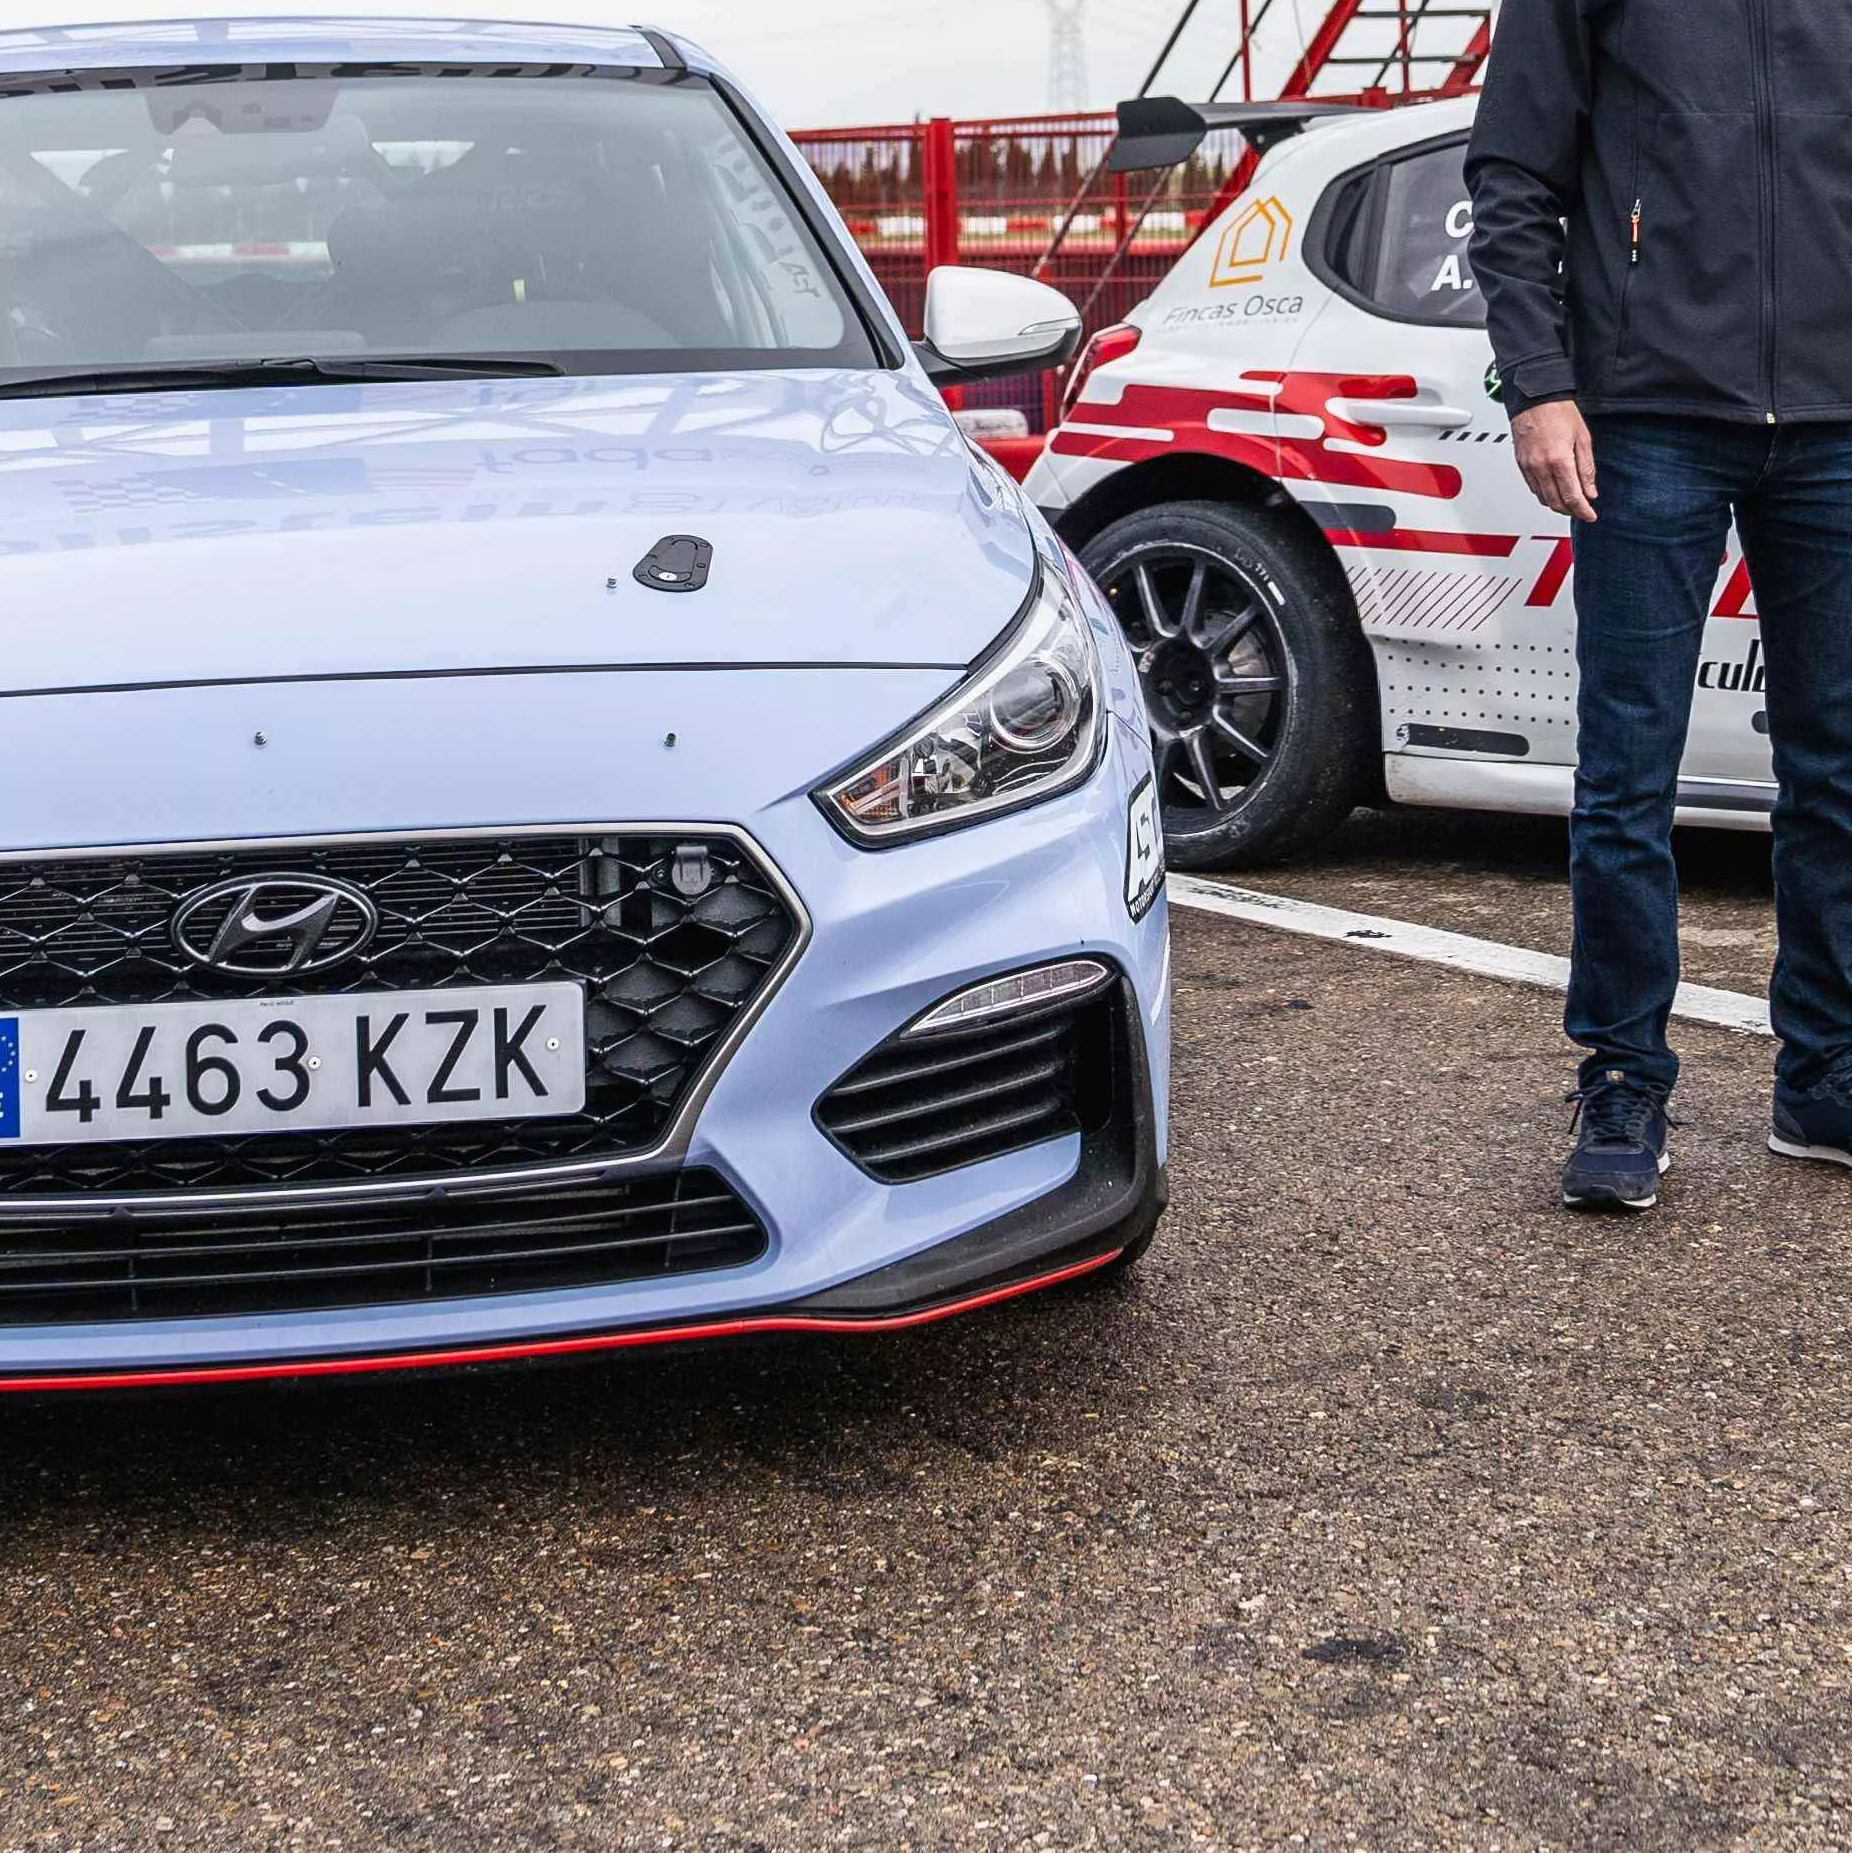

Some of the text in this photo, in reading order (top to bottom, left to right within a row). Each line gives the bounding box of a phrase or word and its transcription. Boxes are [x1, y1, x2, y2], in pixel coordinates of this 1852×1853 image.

[1162, 302, 1239, 326] Fincas
[1243, 294, 1304, 317] Osca
[45, 1019, 310, 1124] 4463
[354, 1003, 550, 1109] KZK
